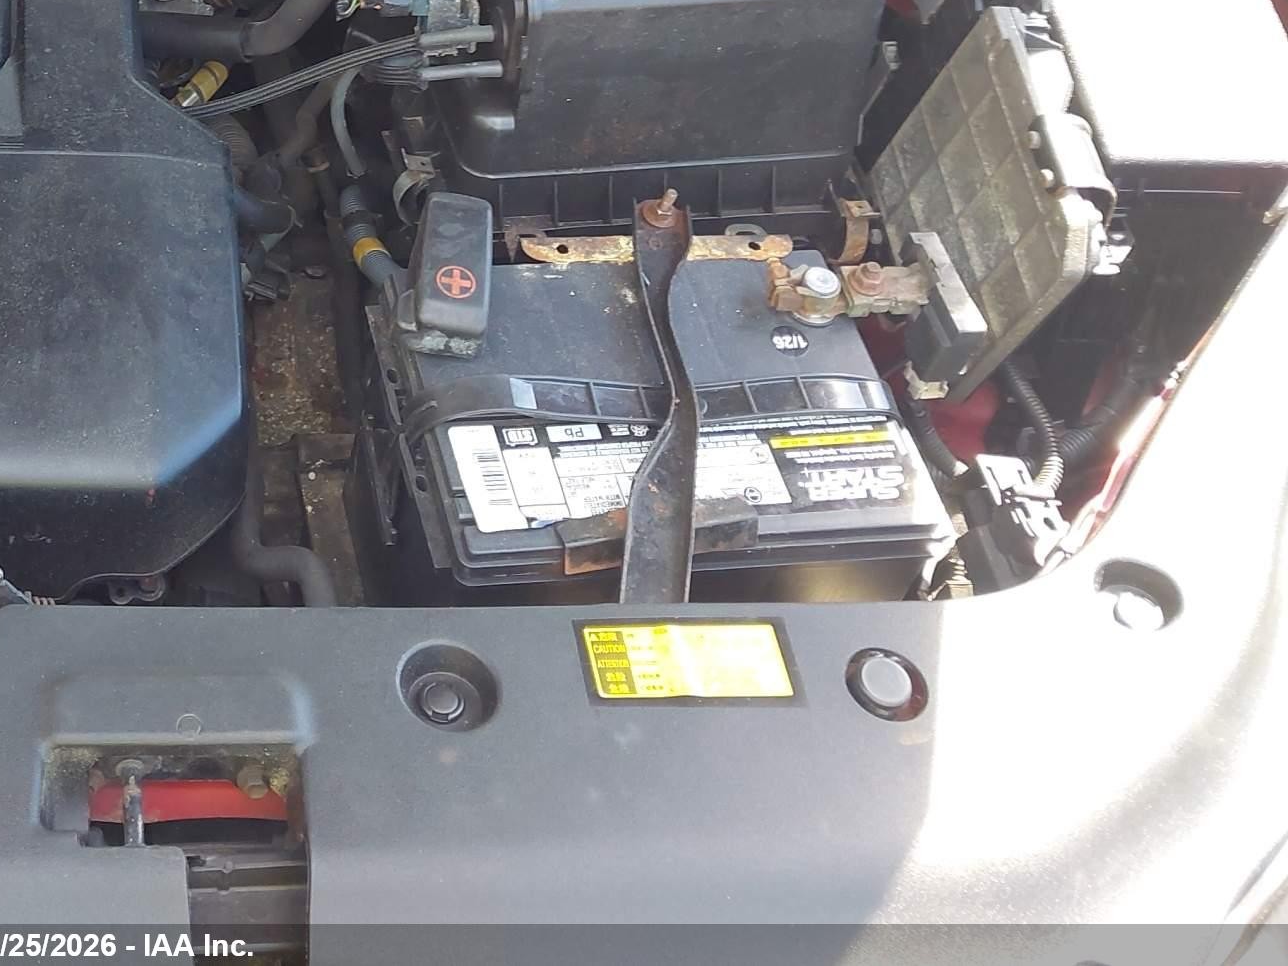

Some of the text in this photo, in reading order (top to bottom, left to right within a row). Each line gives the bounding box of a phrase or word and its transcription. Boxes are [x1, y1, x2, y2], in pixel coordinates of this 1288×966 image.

[564, 427, 585, 439] Pb
[806, 466, 904, 487] START
[808, 486, 900, 501] SUPER
[592, 644, 627, 654] CAUTION
